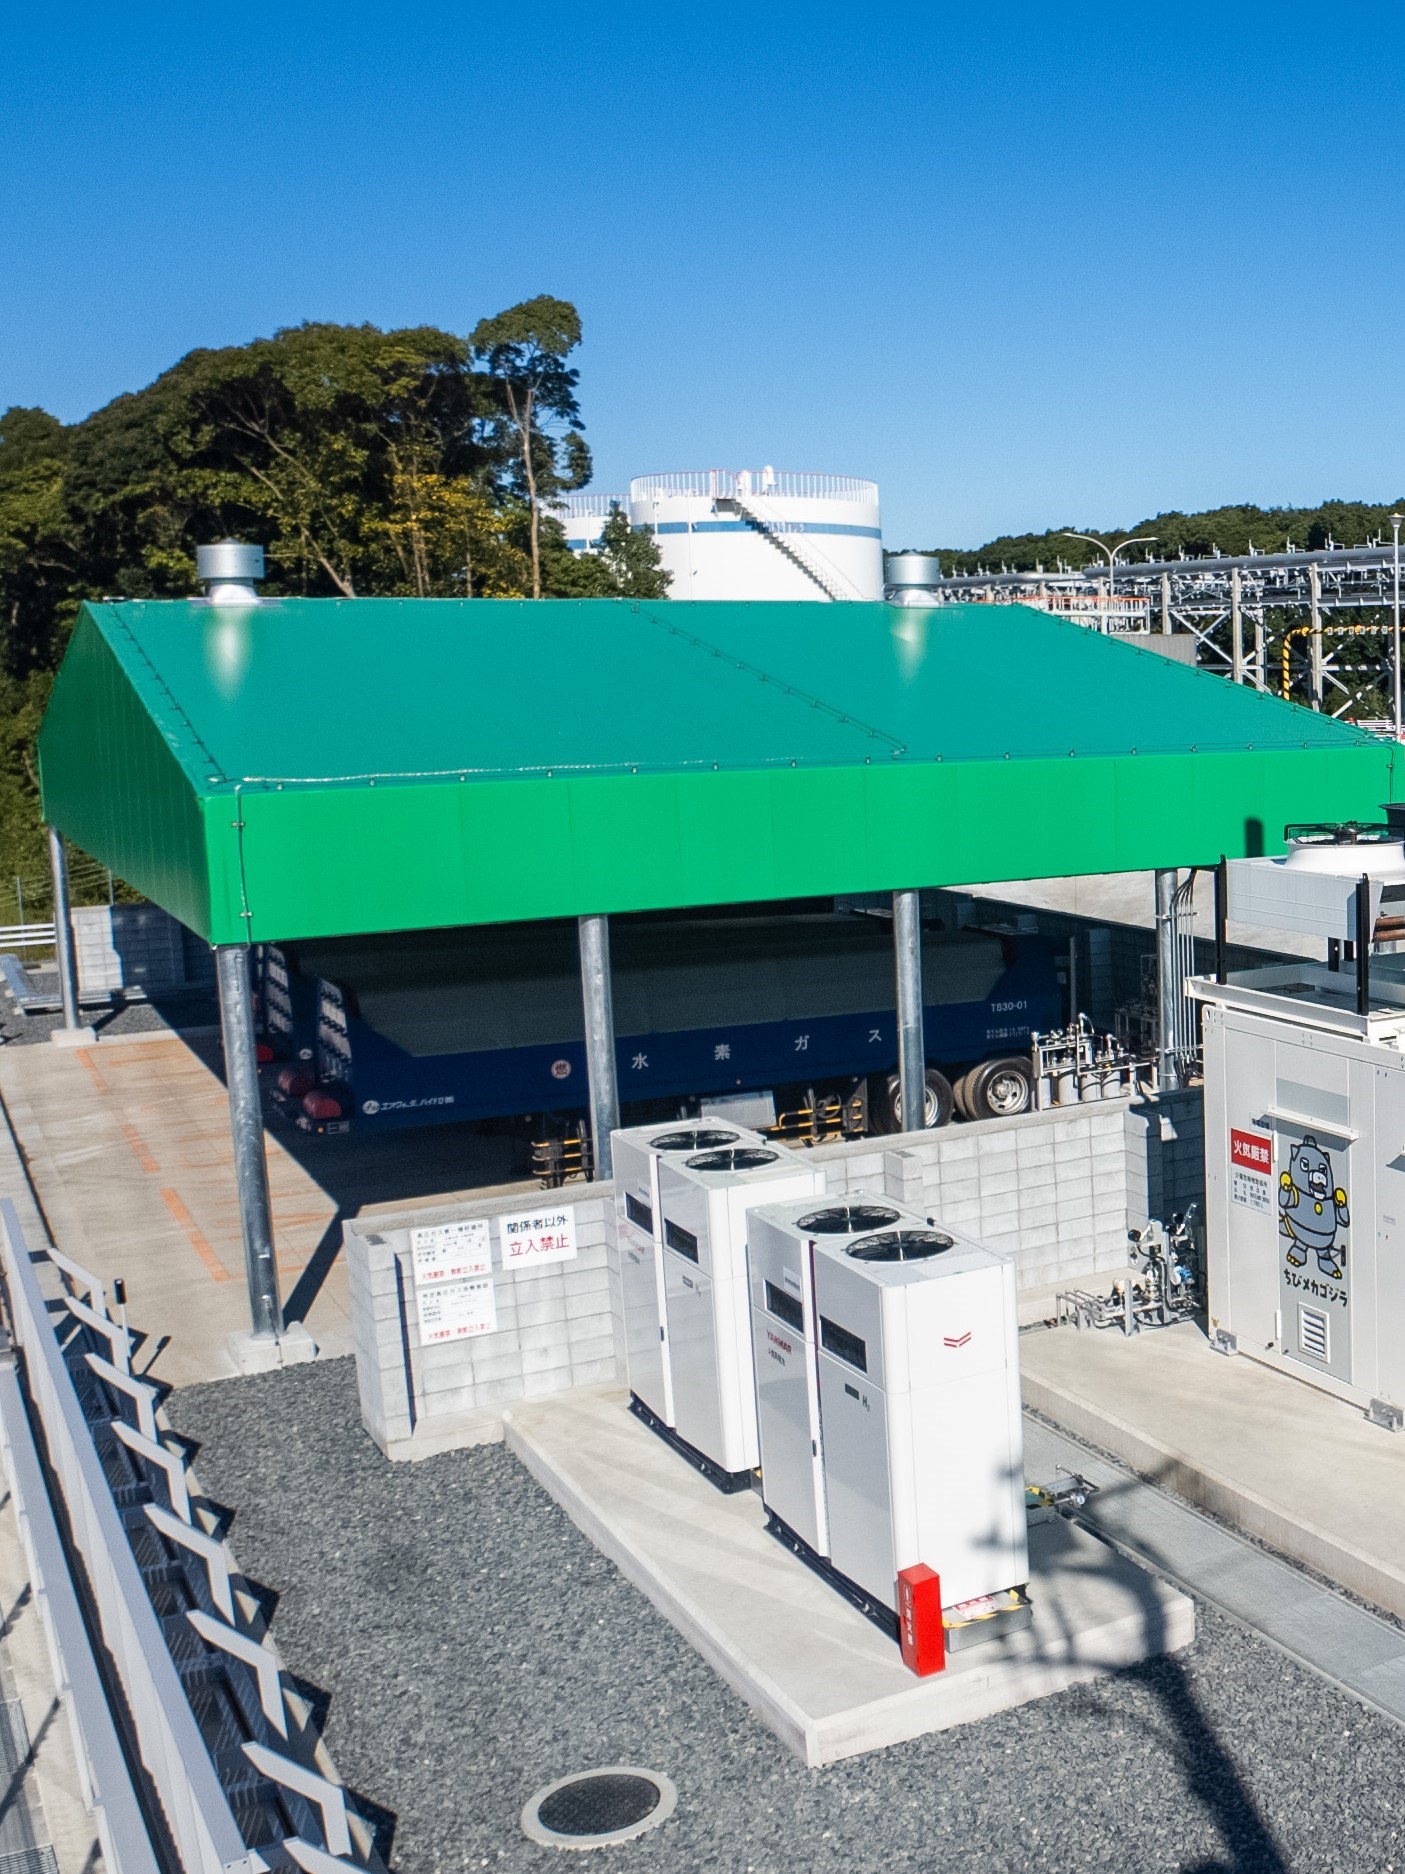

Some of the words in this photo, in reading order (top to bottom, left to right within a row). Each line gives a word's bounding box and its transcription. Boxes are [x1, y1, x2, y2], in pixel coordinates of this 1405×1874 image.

[1233, 1140, 1269, 1164] 火気厳禁
[507, 1214, 568, 1234] 関係者以外
[509, 1233, 570, 1257] 立入禁止
[1283, 1268, 1348, 1307] ちびメカゴジラ
